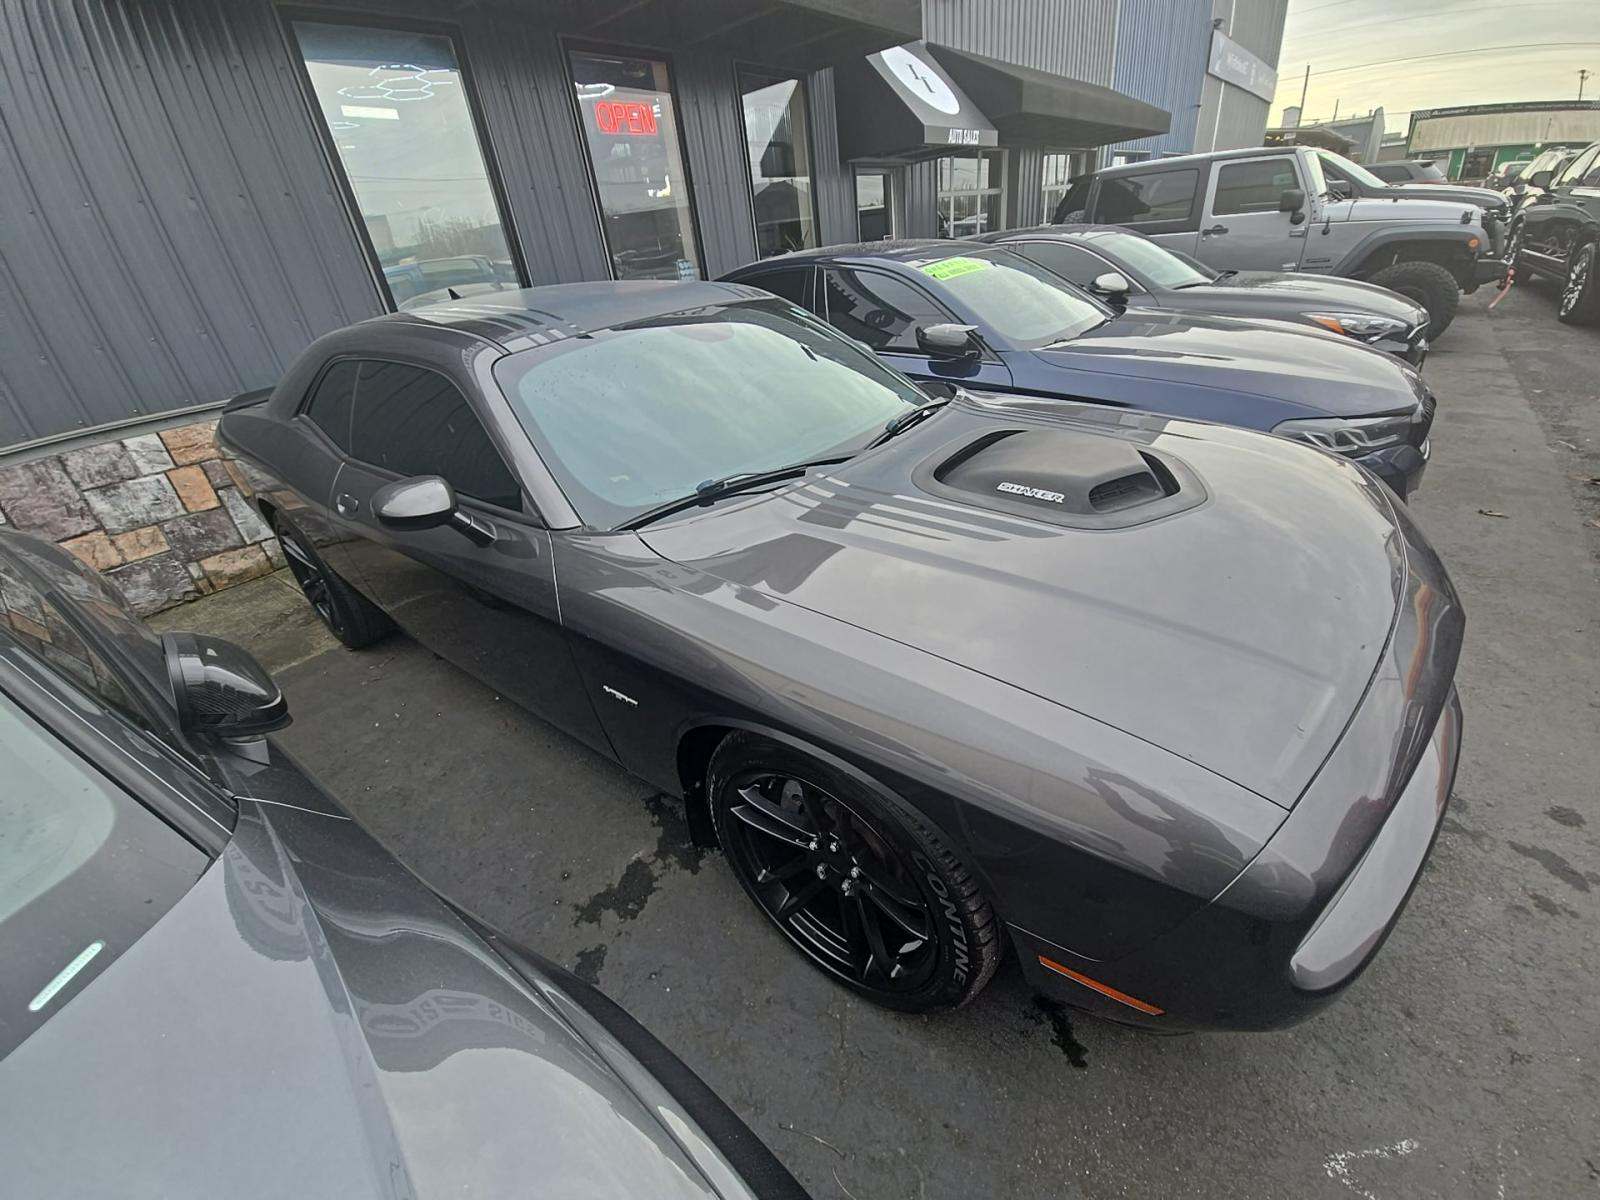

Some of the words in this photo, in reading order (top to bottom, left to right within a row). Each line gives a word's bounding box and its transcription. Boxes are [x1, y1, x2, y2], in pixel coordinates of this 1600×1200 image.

[595, 101, 657, 135] OPEN
[948, 128, 963, 144] AUTO
[963, 129, 980, 145] SALES
[996, 482, 1065, 503] SHAKER
